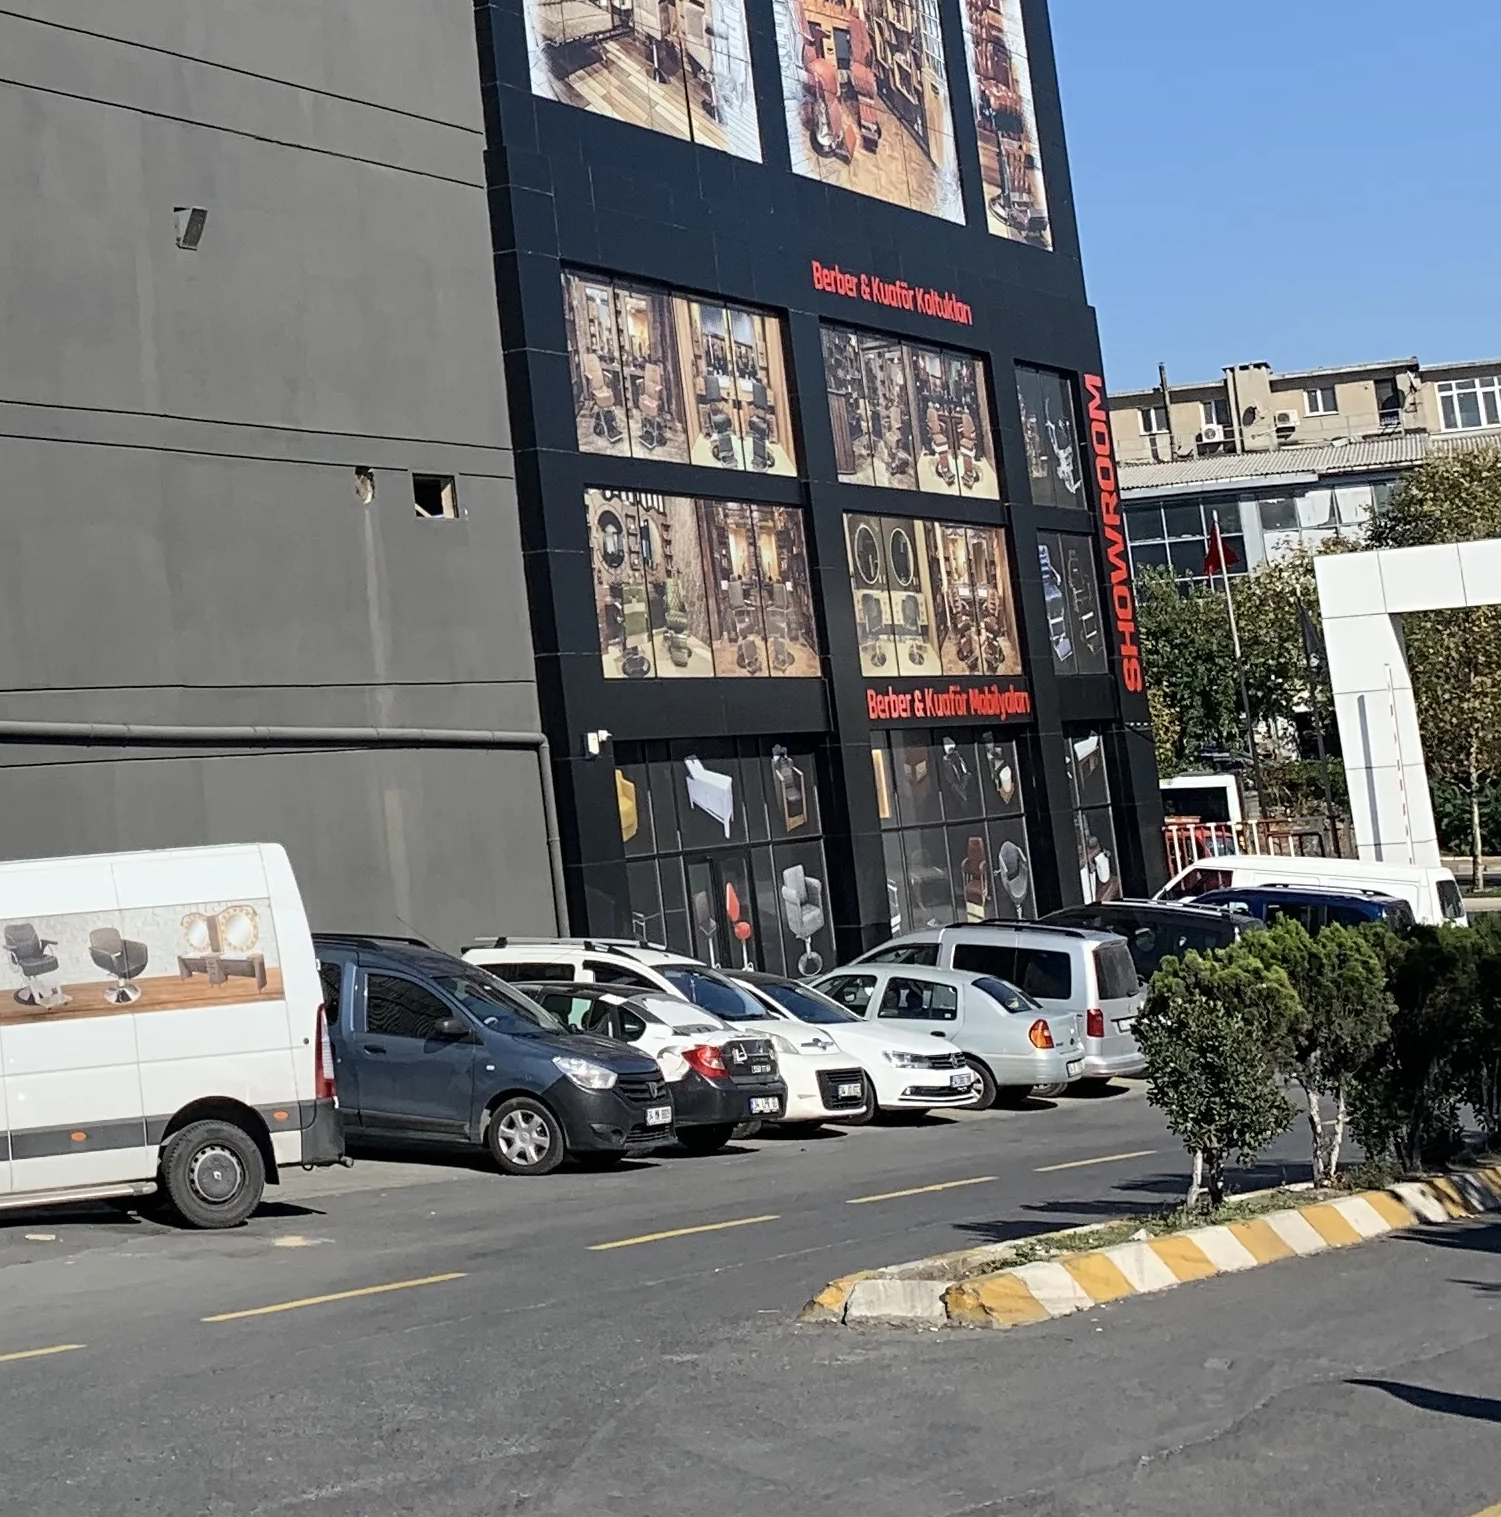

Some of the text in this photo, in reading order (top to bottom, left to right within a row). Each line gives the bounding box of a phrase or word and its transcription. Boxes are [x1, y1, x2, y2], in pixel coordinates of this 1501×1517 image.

[811, 260, 858, 298] Berber
[860, 273, 871, 301] &
[871, 276, 914, 311] Kuaför
[1083, 373, 1144, 693] SHOWROOM
[867, 686, 911, 720] Berber
[913, 689, 924, 718] &
[924, 685, 968, 718] Kuaför
